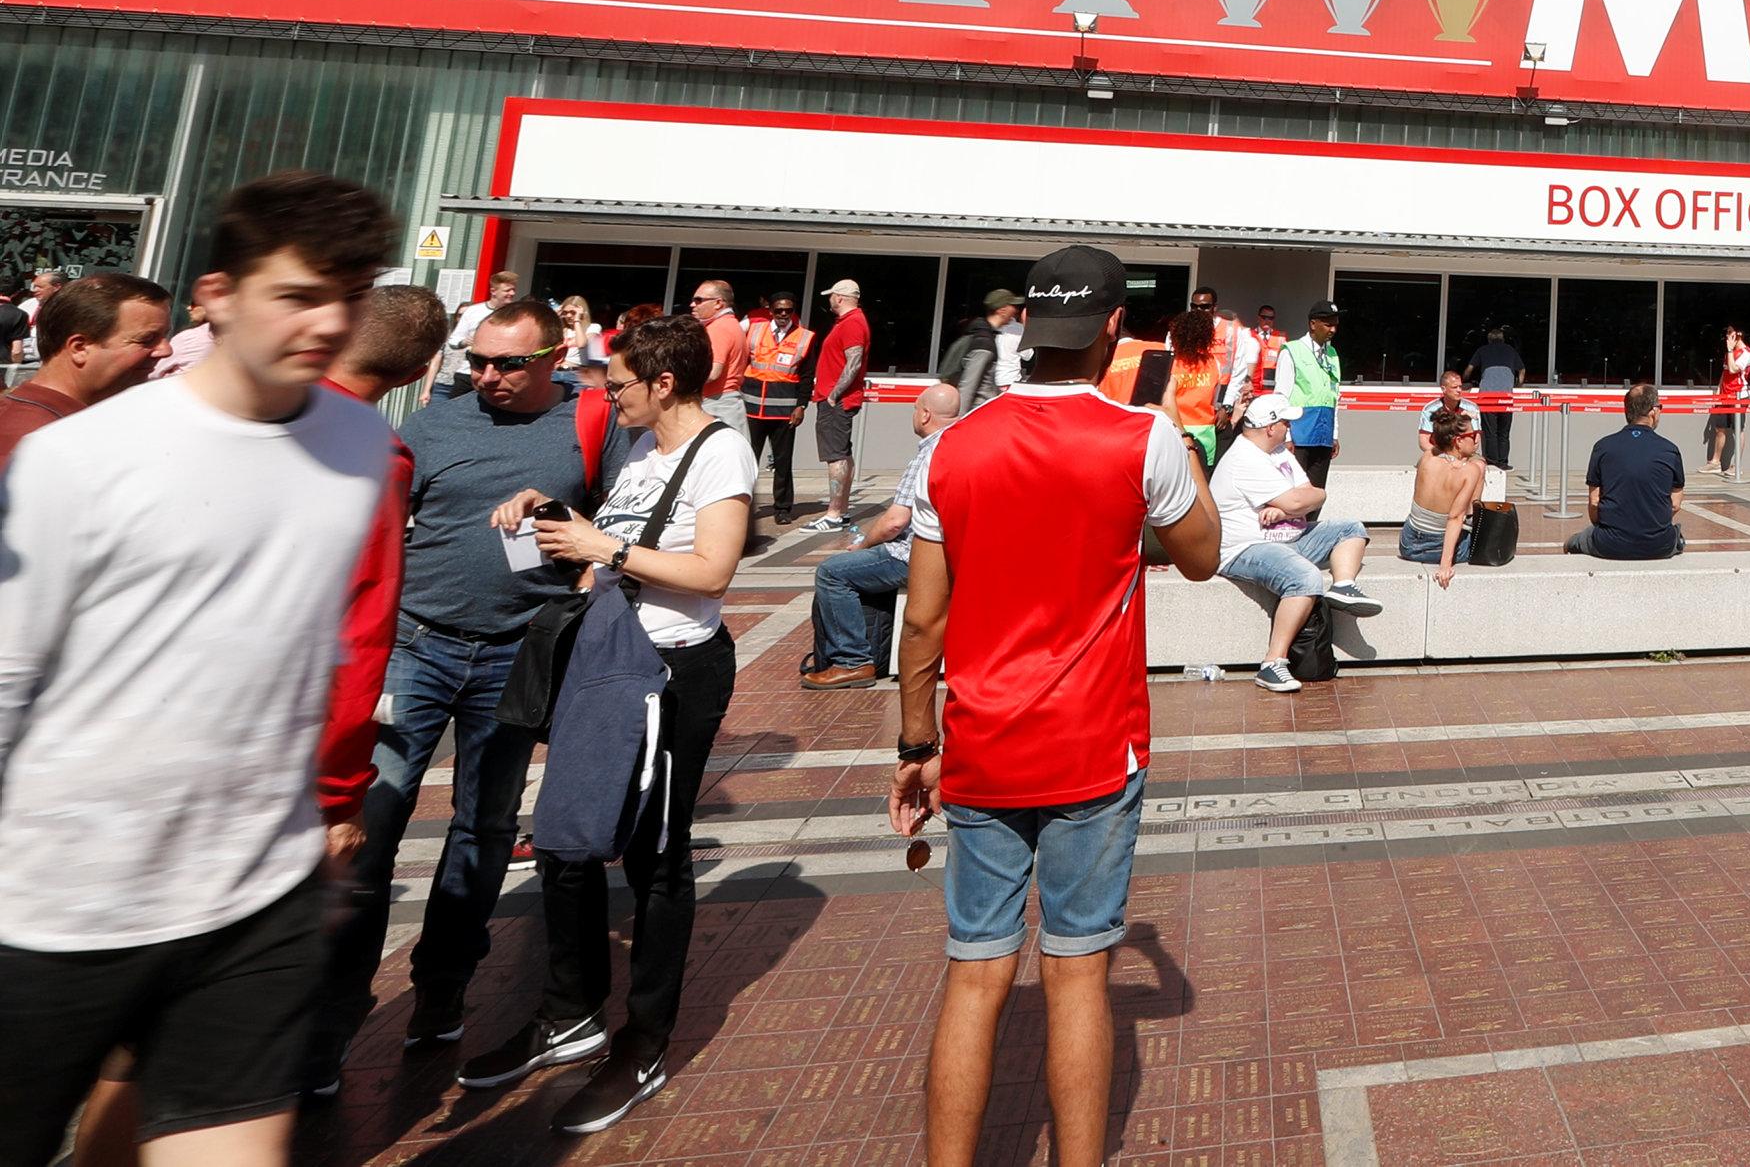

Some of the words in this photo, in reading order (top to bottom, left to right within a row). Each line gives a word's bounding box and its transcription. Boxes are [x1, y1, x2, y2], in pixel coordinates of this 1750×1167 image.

[0, 169, 107, 191] RANCE
[1547, 183, 1641, 228] BOX
[1269, 410, 1278, 421] 3
[1408, 804, 1708, 832] FOOTBALL
[1215, 827, 1375, 845] CLUB
